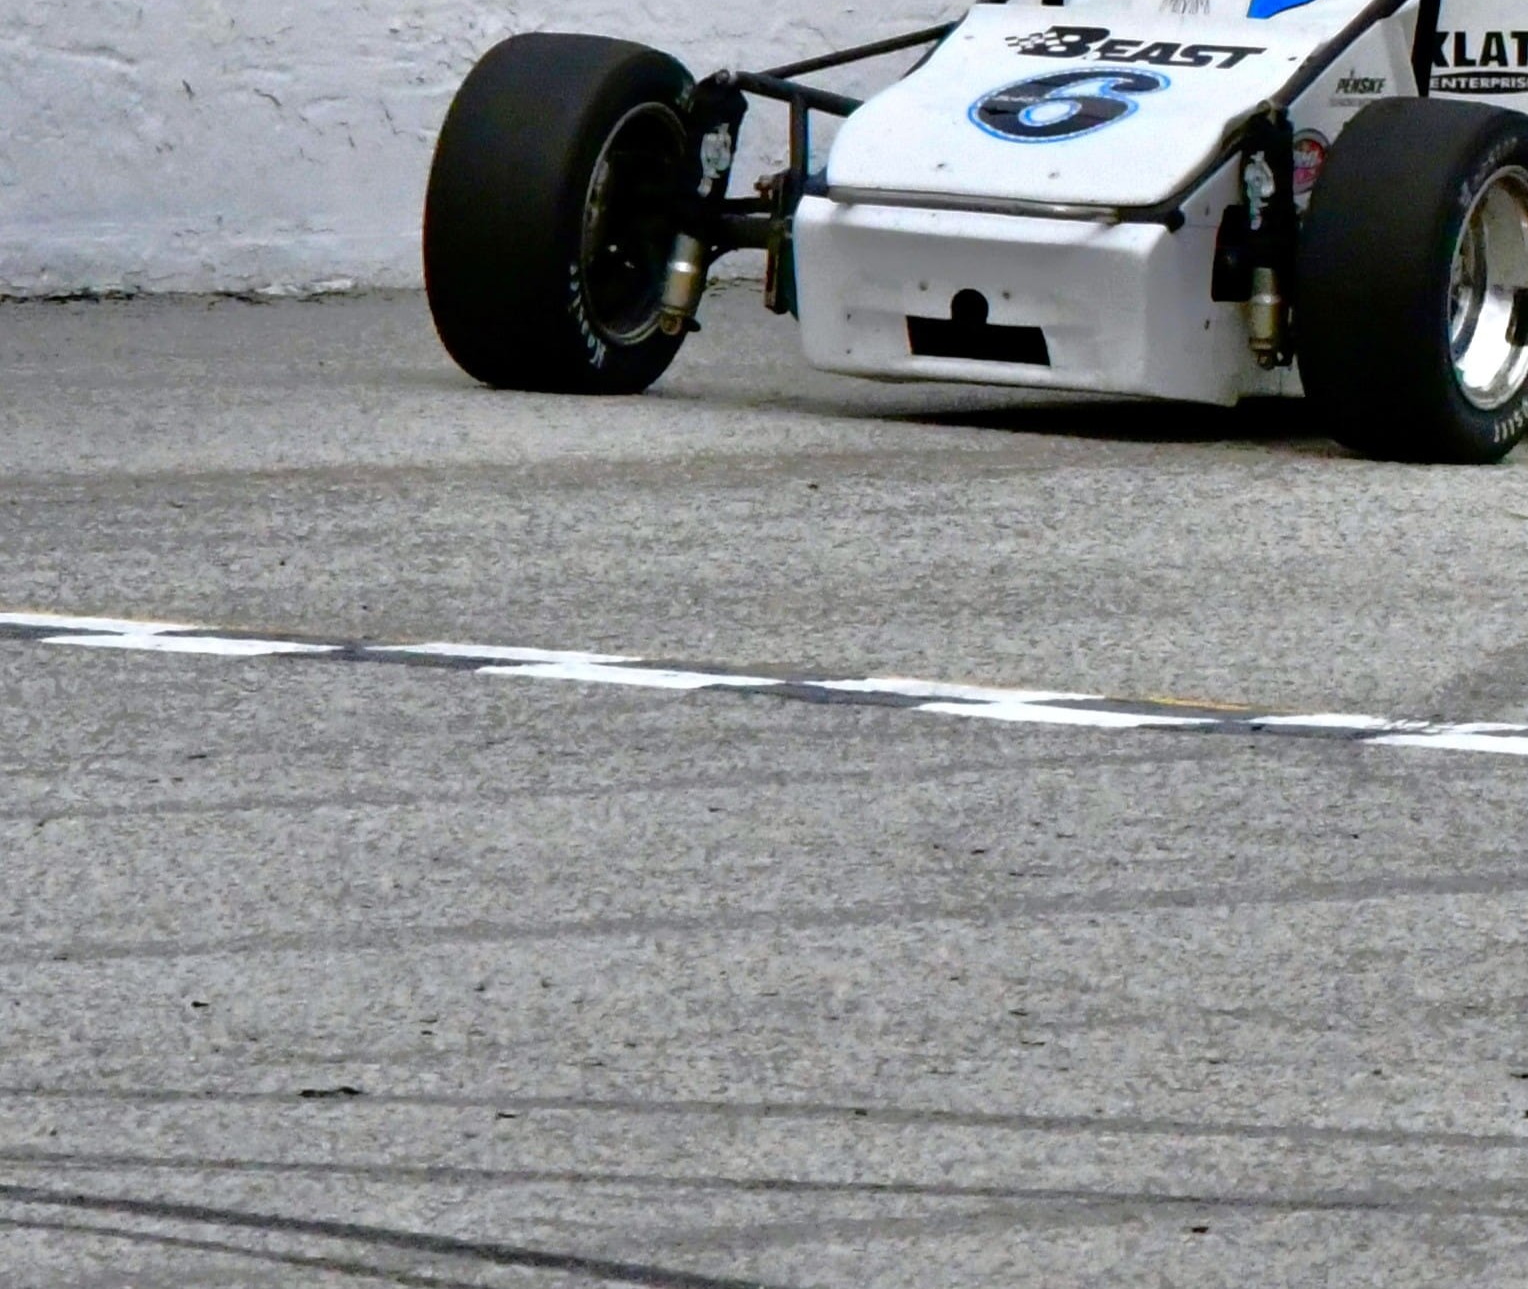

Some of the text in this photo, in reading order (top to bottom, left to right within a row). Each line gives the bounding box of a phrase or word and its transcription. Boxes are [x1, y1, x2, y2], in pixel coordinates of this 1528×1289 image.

[1009, 25, 1267, 70] BEAST
[968, 66, 1171, 144] 6
[1335, 75, 1386, 94] PENSKE
